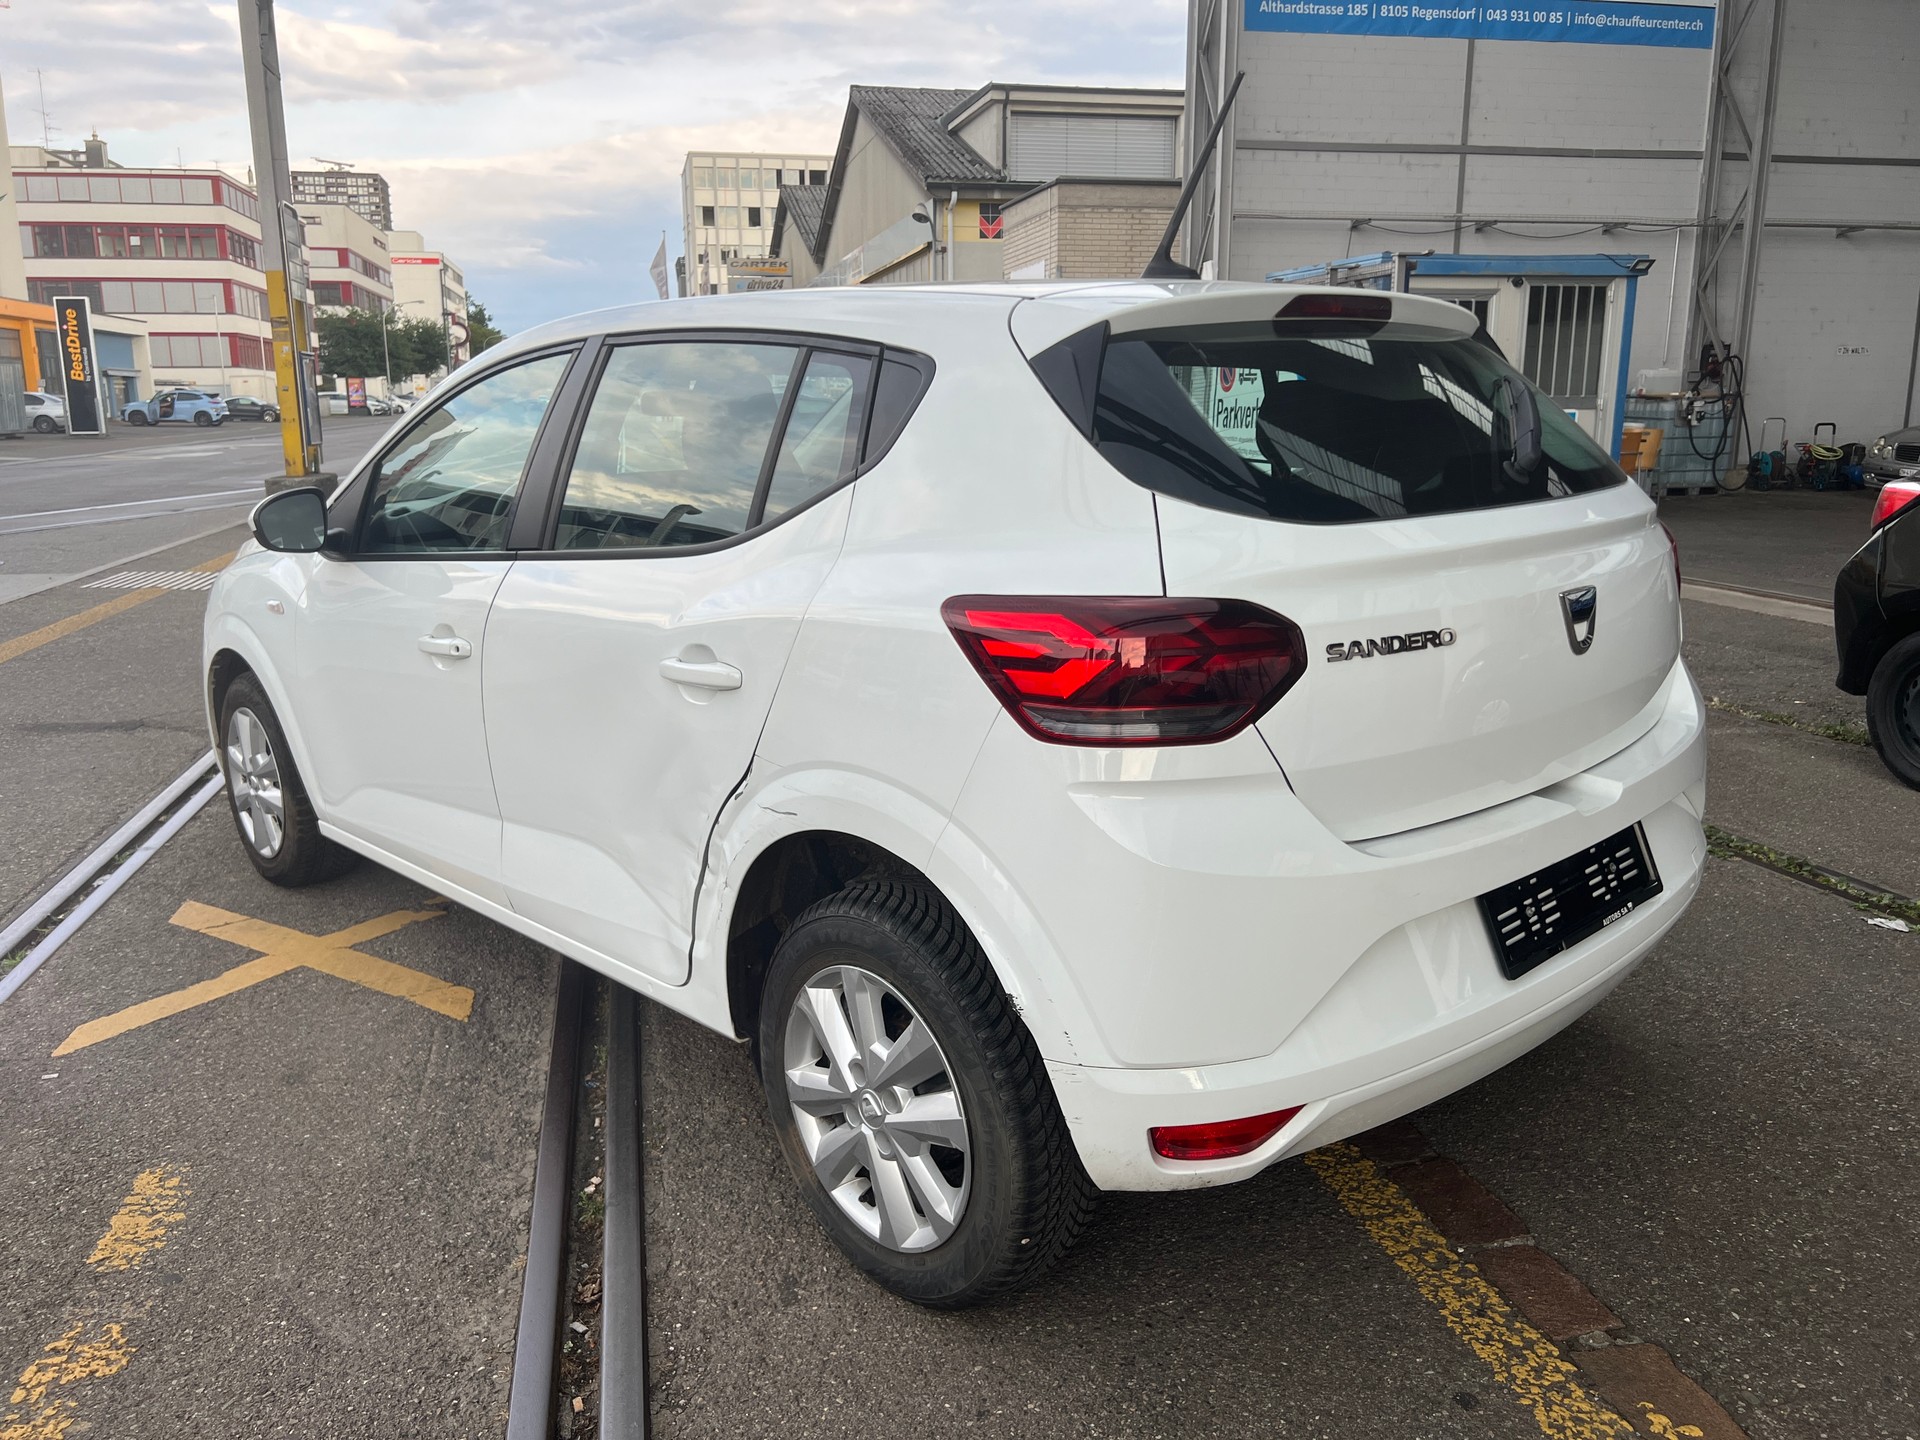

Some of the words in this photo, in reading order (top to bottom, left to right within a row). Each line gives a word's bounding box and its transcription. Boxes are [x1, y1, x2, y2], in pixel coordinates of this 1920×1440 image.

[1259, 2, 1344, 16] Althardstrasse
[1347, 4, 1368, 16] 185
[1380, 5, 1409, 18] 8105
[1412, 8, 1476, 21] Regensdorf
[1486, 9, 1508, 21] 043
[1510, 10, 1530, 22] 931
[1533, 11, 1547, 23] 00
[1549, 12, 1563, 24] 85
[1574, 13, 1704, 31] info@chauffeurcenter.ch
[747, 279, 785, 290] drive24
[62, 307, 85, 382] BestDrive
[1326, 627, 1458, 663] SANDERO
